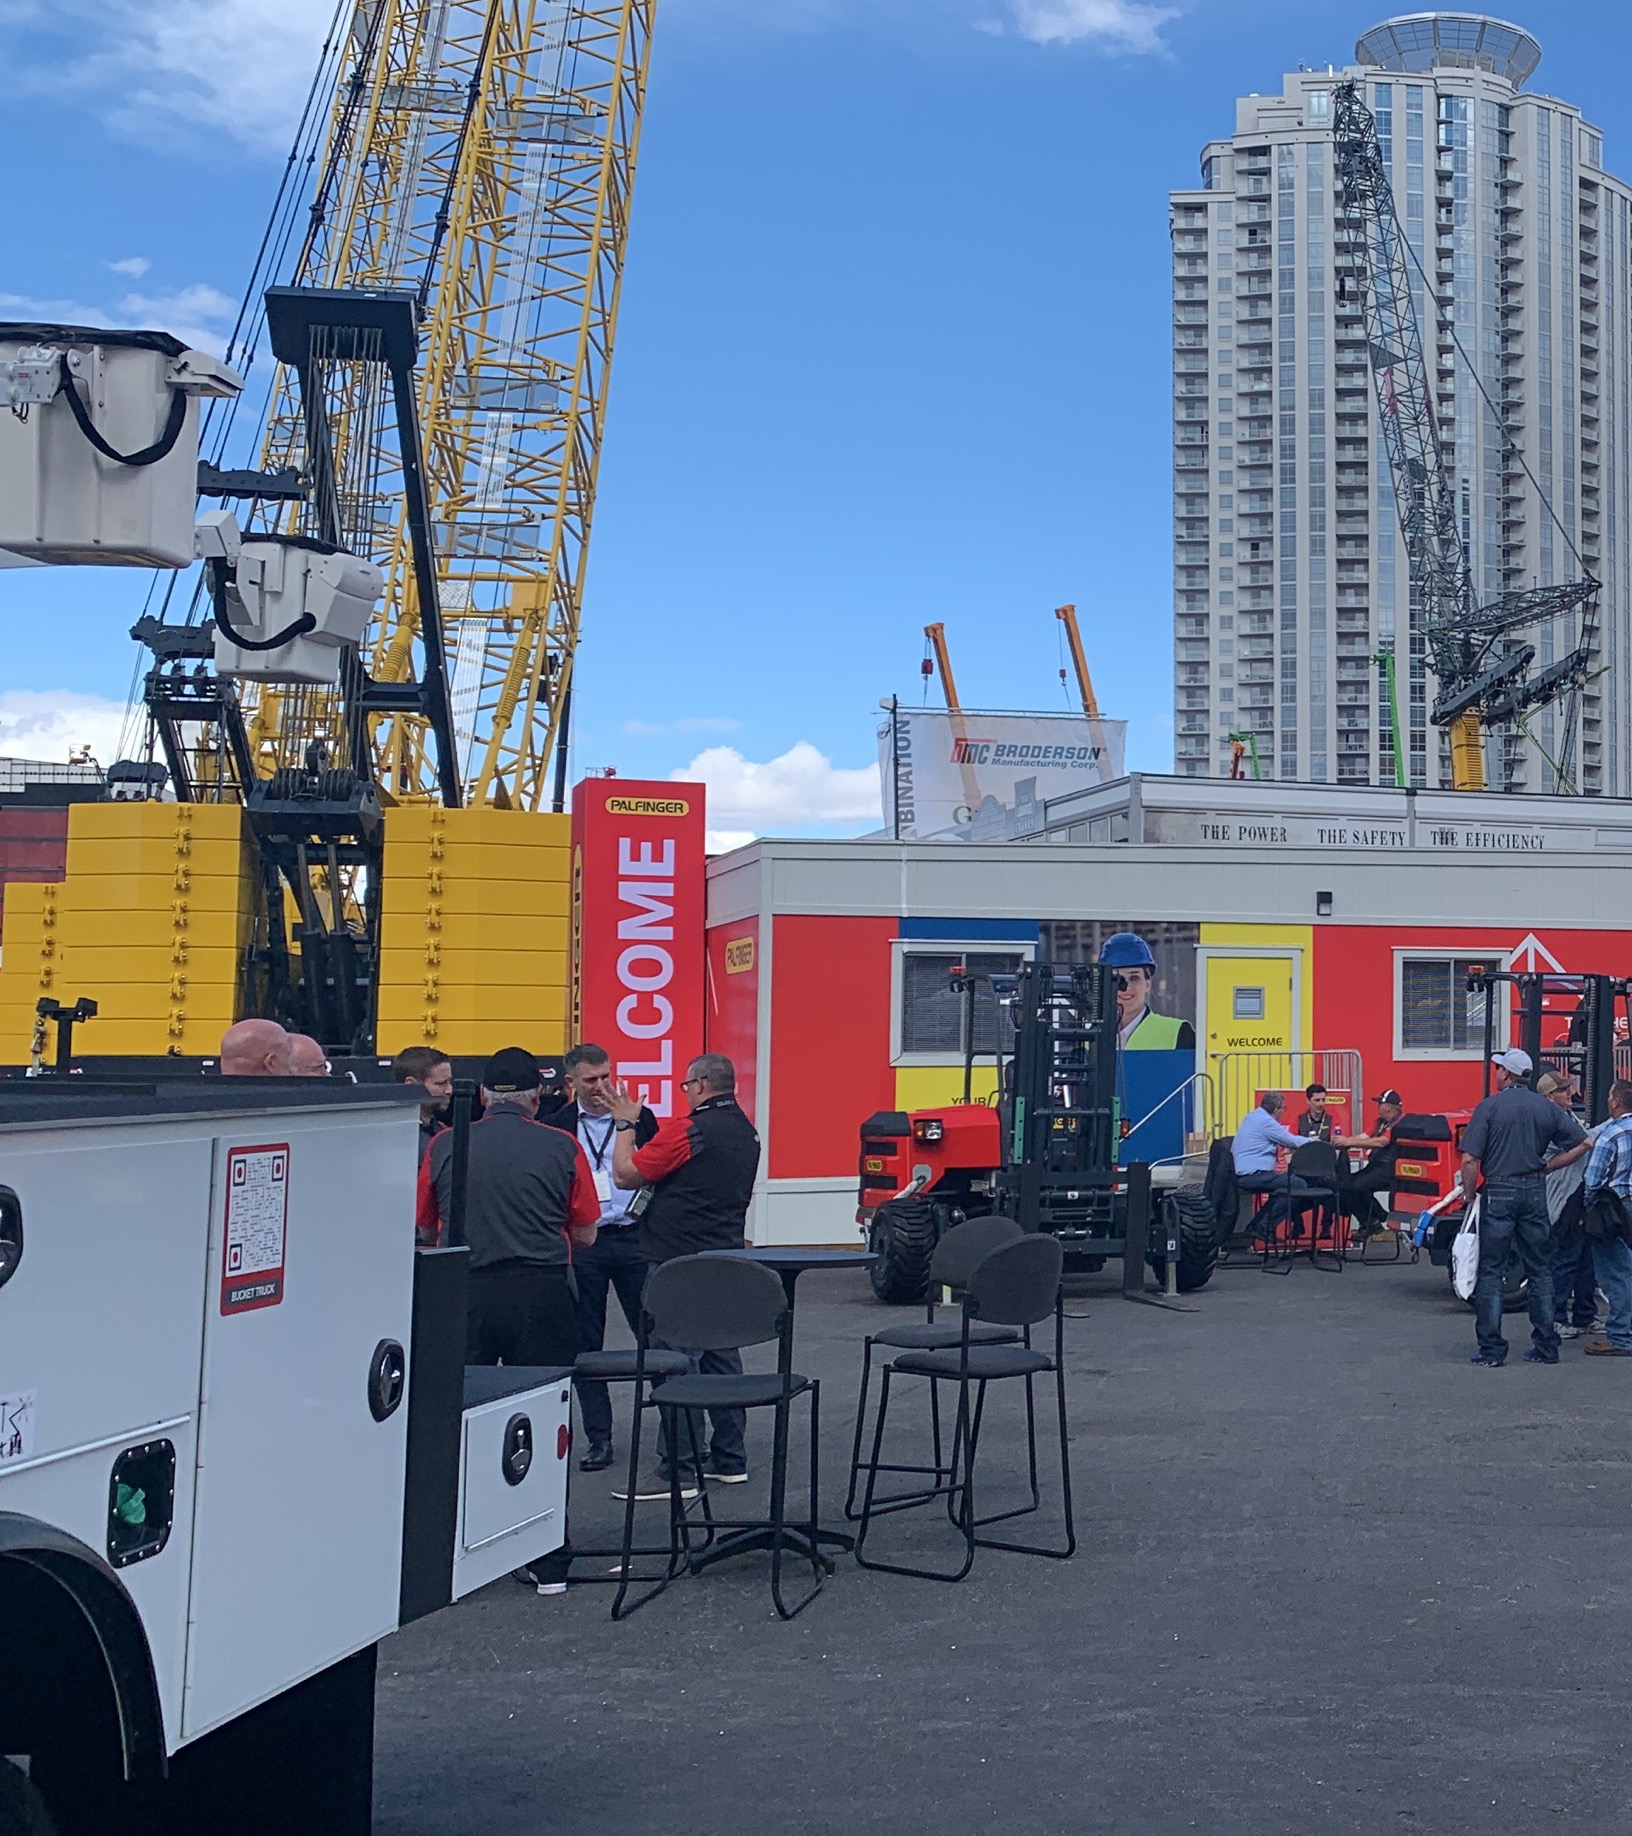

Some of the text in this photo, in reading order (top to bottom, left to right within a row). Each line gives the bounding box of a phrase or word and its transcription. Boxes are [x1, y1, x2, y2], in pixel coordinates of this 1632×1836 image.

[994, 744, 1101, 760] BRODERSON
[897, 720, 915, 824] BINATION
[991, 758, 1099, 770] Manufacturing Corp.
[611, 799, 684, 814] PALFINGER
[1200, 824, 1287, 842] THE POWER
[1317, 828, 1406, 847] THE SAFETY
[1431, 830, 1545, 849] THE EFFICIENCY
[615, 836, 676, 1119] ELCOME
[1227, 1037, 1283, 1047] WELCOME
[231, 1284, 276, 1302] BUCKET TRUCK
